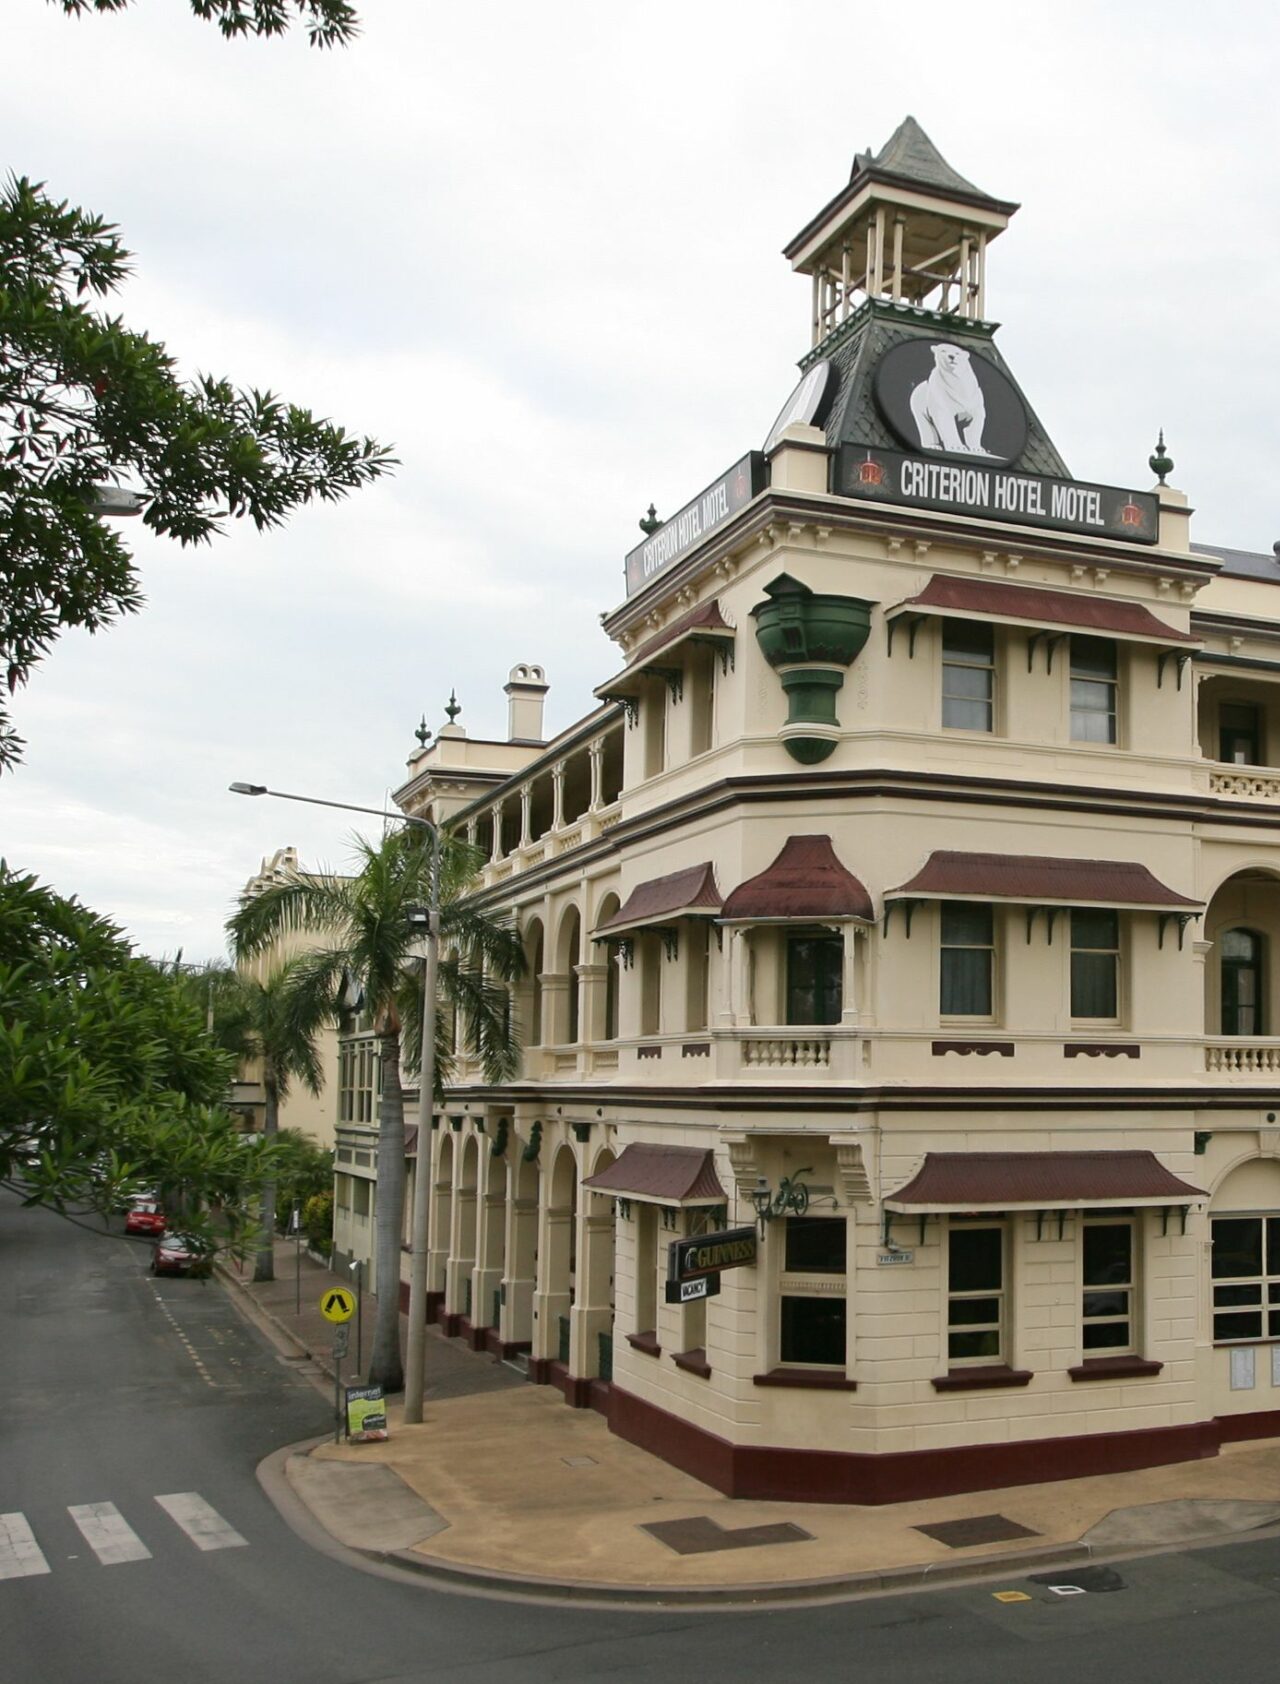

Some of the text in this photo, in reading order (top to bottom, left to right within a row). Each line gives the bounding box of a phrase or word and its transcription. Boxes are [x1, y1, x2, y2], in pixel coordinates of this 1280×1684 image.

[900, 460, 1105, 526] CRITERION HOTEL MOTEL
[643, 482, 729, 577] CRITERION HOTEL MOTEL
[698, 1240, 755, 1268] GUINNESS
[682, 1280, 705, 1297] VACANCY
[347, 1388, 381, 1401] internet
